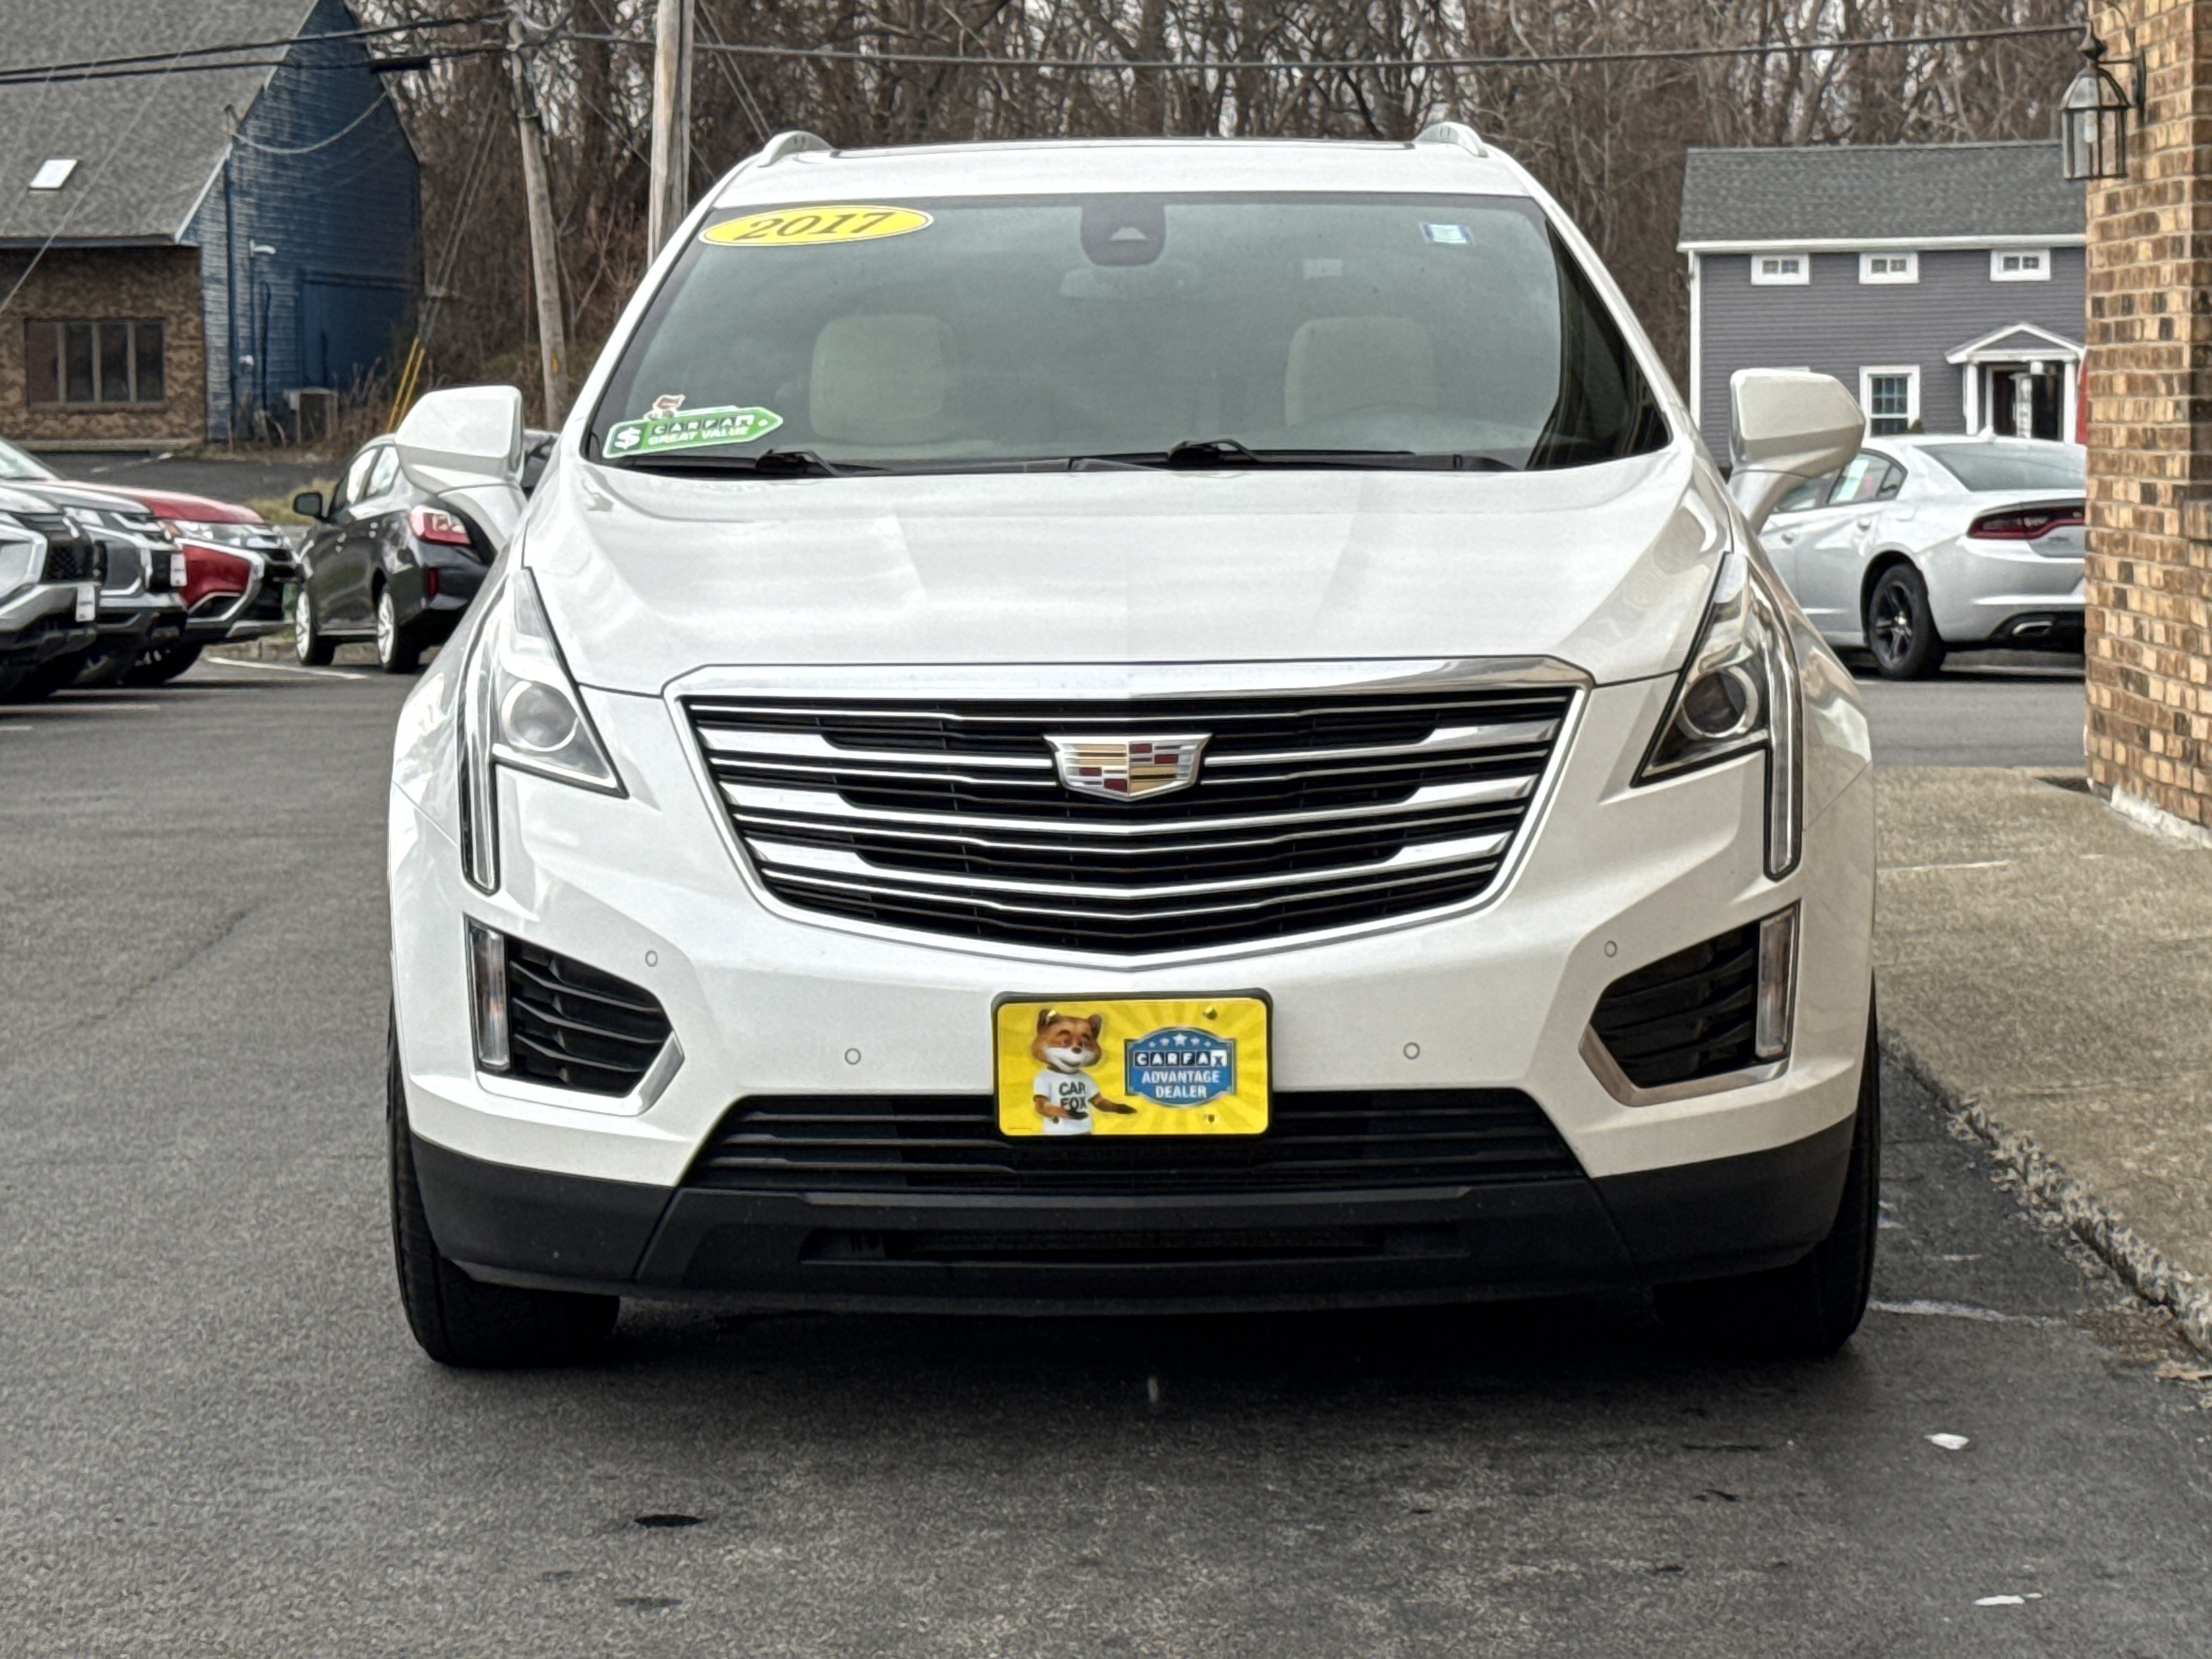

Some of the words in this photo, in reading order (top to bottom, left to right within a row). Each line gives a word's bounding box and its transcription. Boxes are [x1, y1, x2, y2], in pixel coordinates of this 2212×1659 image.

[732, 212, 896, 240] 2017
[653, 415, 755, 436] CARFA
[701, 427, 749, 439] VALUE
[1135, 1050, 1228, 1067] CARFAX
[1141, 1071, 1219, 1084] ADVANTAGE
[1058, 1081, 1086, 1096] CAR
[1155, 1085, 1207, 1098] DEALER
[1060, 1096, 1087, 1111] FOX
